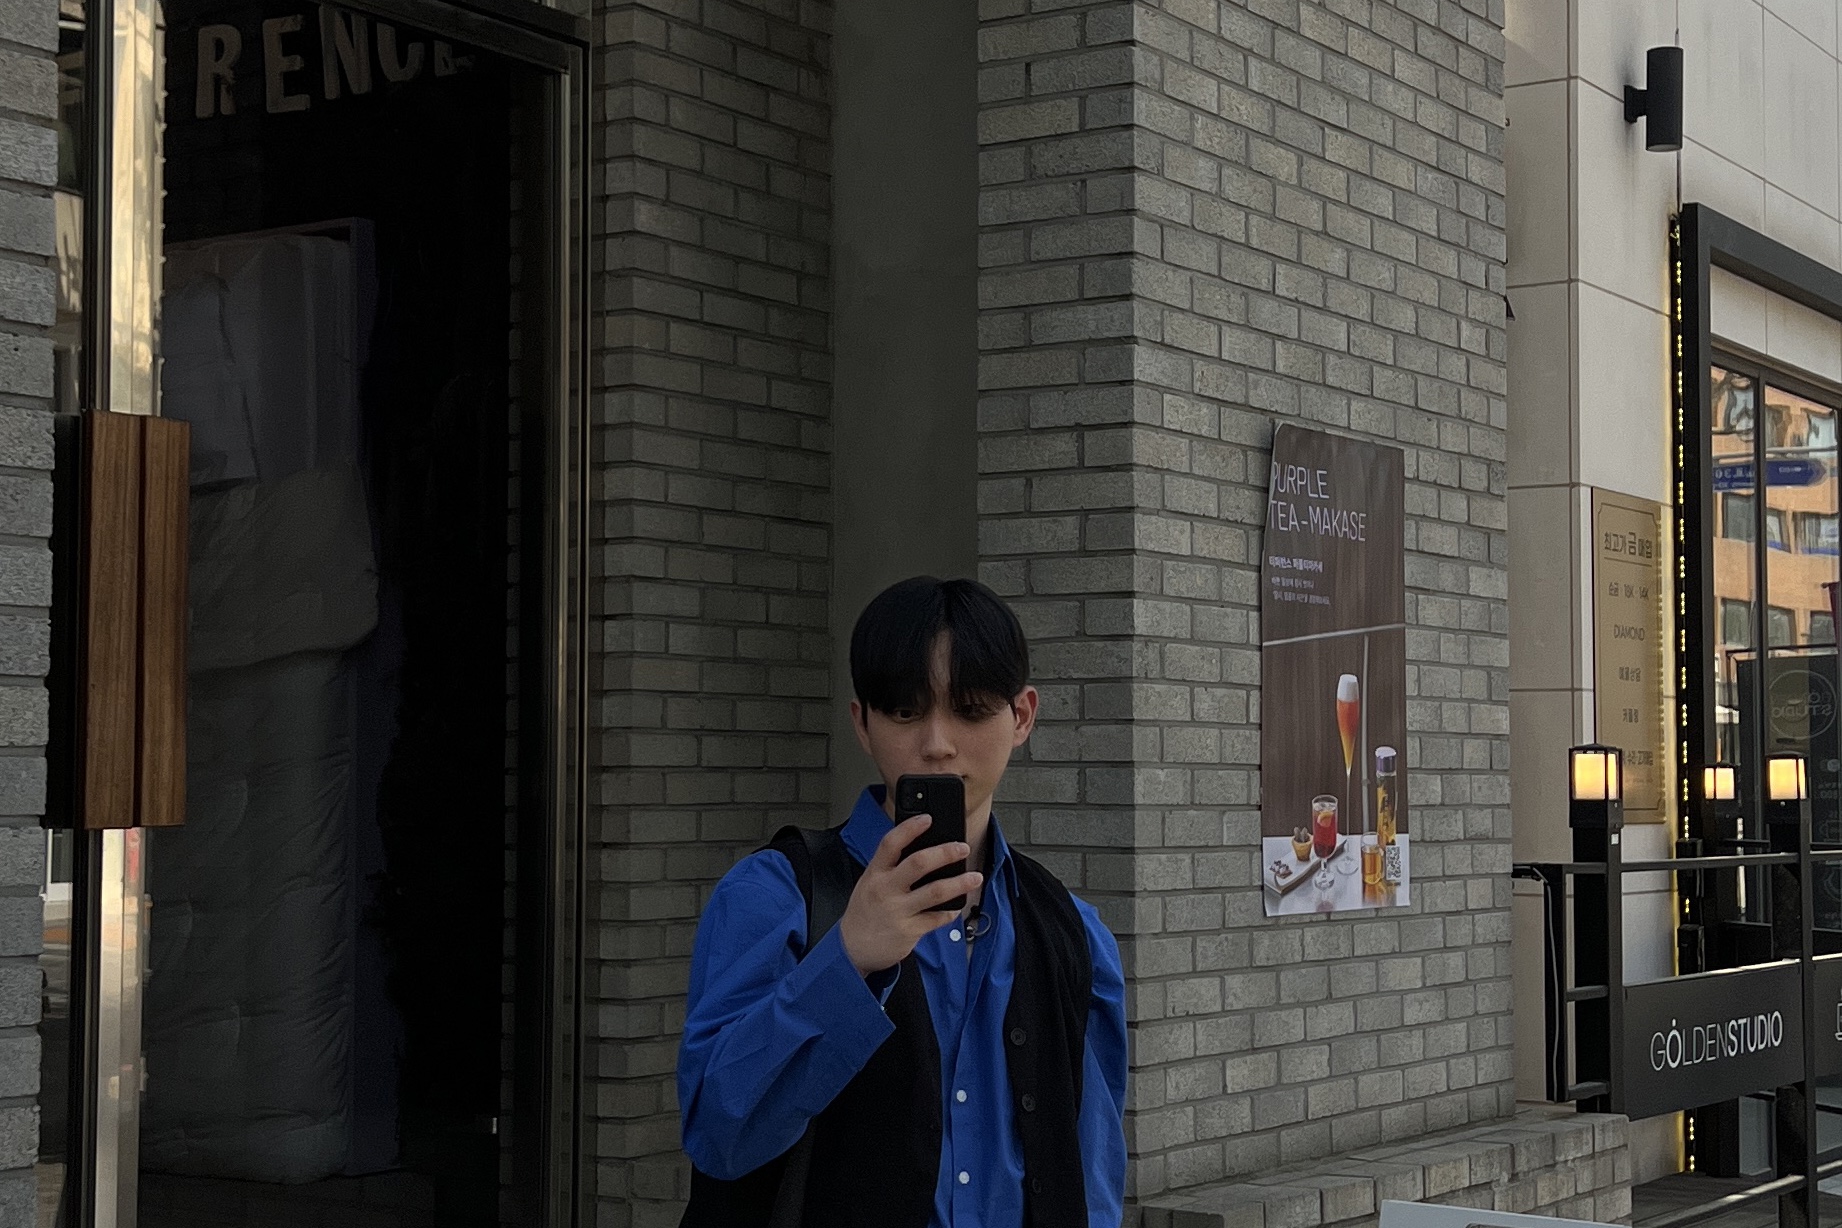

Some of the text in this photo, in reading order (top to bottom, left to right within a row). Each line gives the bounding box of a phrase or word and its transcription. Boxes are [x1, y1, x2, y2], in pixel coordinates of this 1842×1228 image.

[1273, 461, 1329, 498] PURPLE
[1270, 500, 1366, 541] TEA-MAKASE
[1613, 624, 1645, 641] DIAMOND
